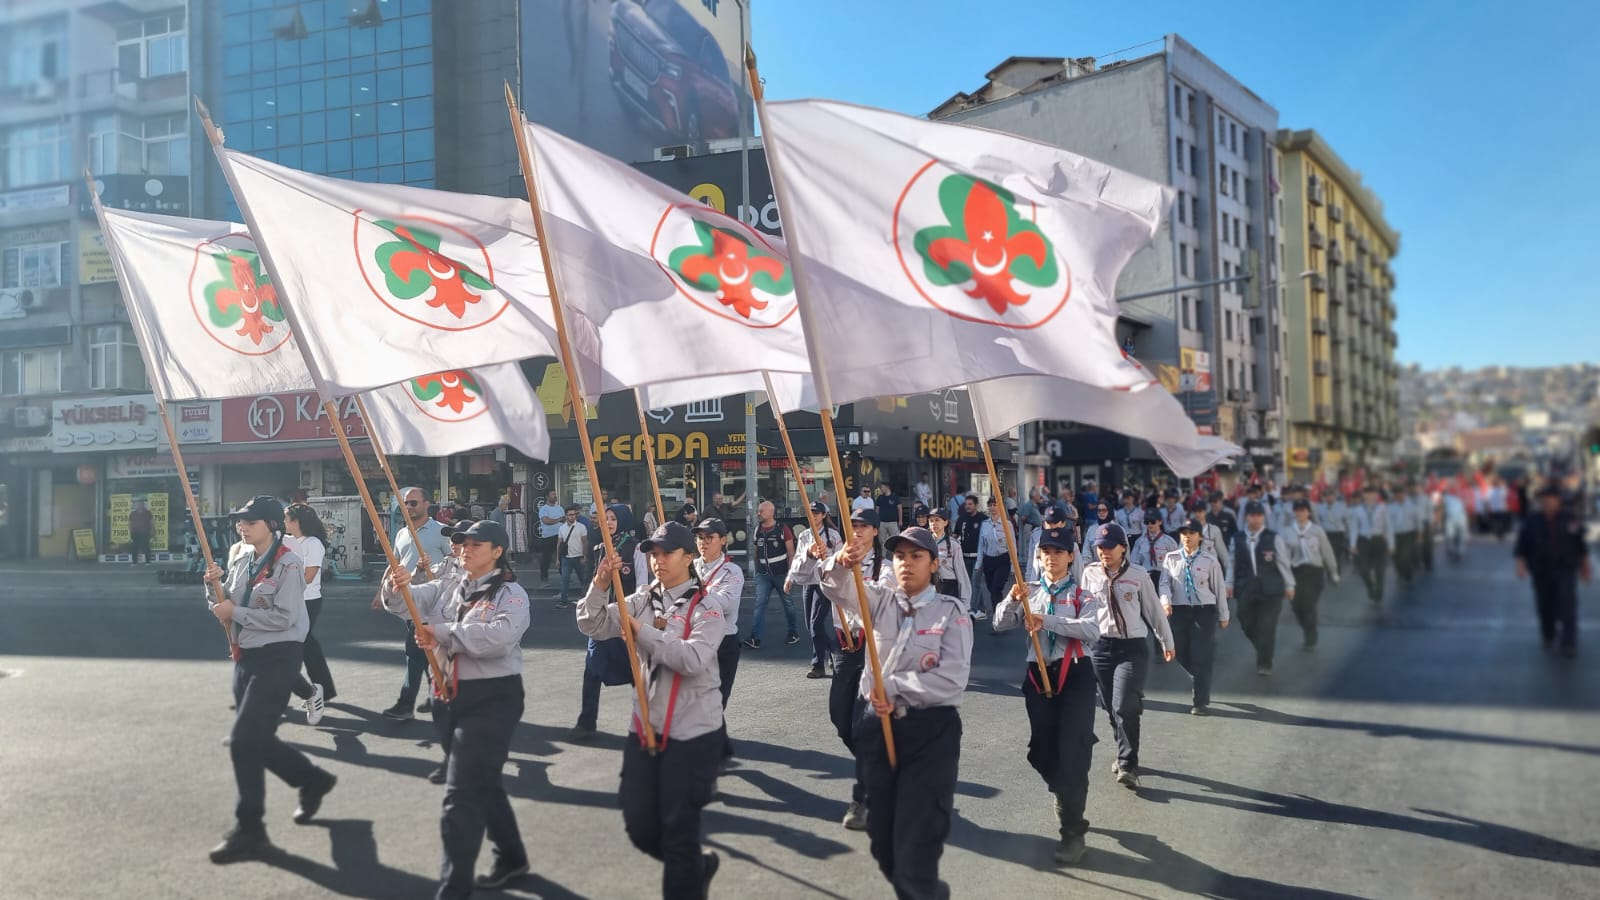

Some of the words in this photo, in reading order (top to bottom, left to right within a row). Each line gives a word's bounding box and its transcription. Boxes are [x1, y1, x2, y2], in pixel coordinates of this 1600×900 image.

[593, 431, 709, 461] FERDA
[728, 433, 746, 442] YETK
[919, 432, 963, 459] FERDA
